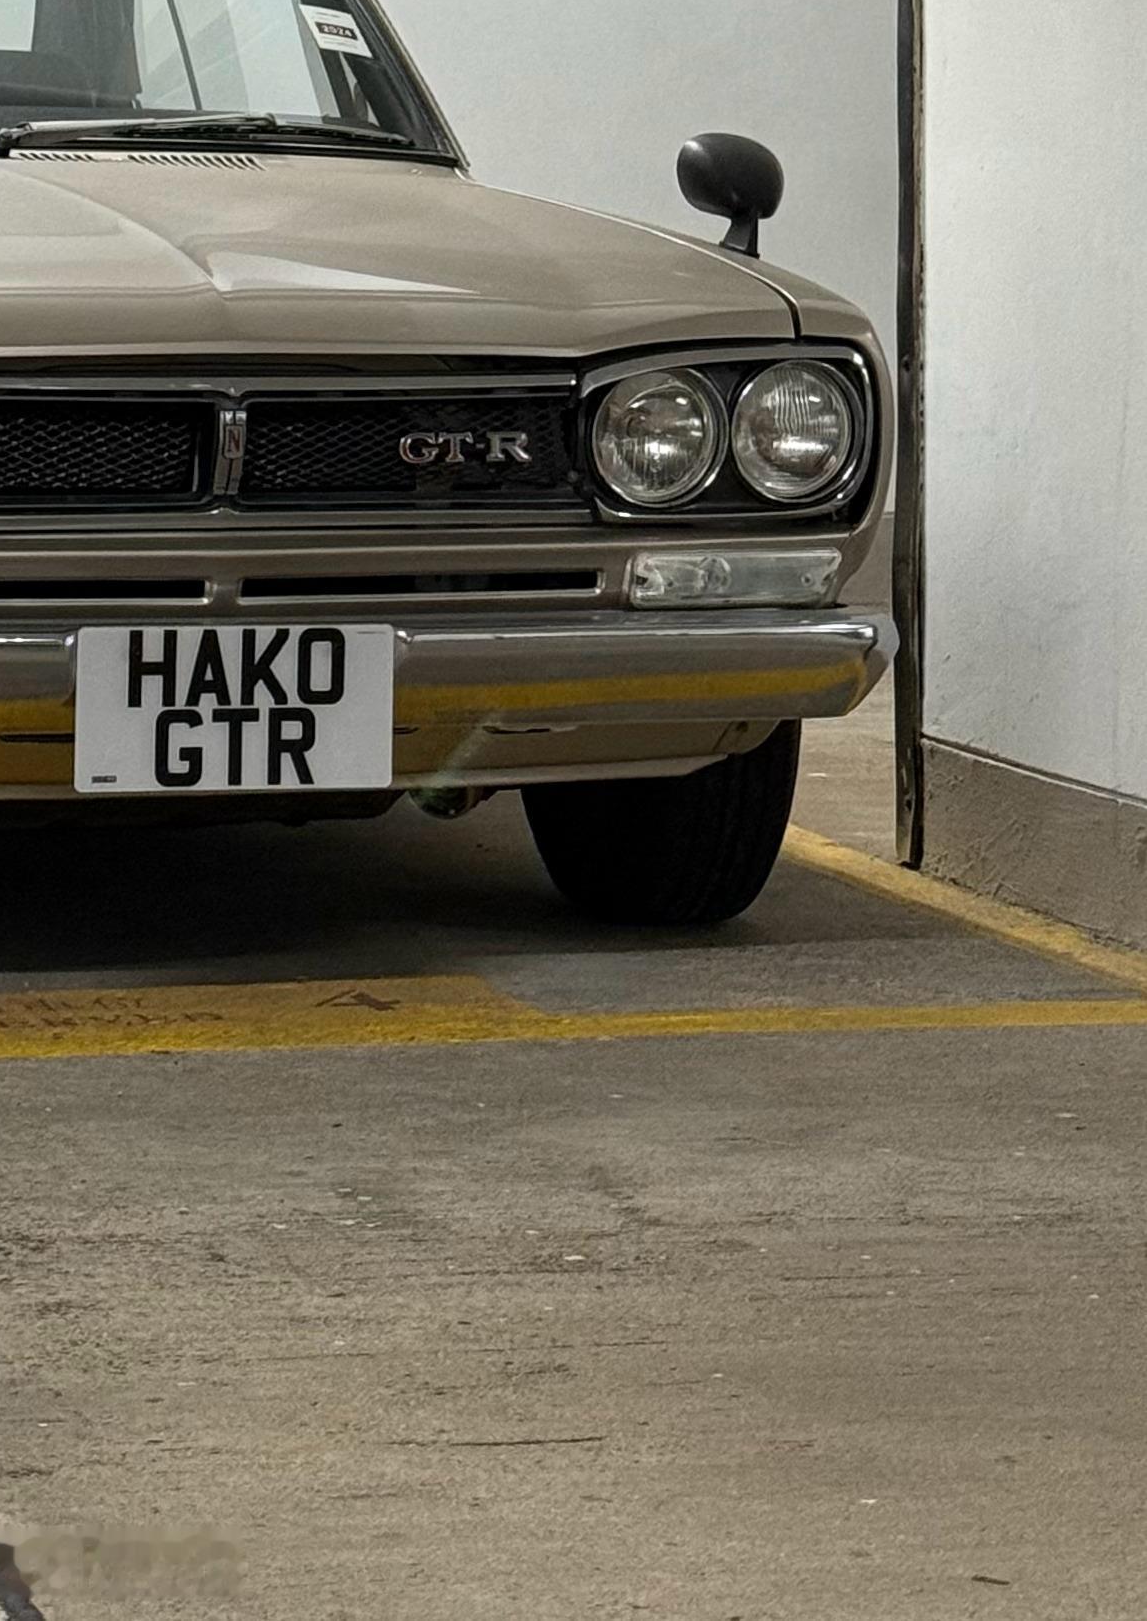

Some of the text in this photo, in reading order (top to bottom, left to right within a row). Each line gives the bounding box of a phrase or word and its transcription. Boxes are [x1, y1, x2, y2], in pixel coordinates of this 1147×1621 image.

[399, 431, 533, 464] GT-R
[127, 628, 346, 708] HAKO
[154, 707, 316, 788] GTR
